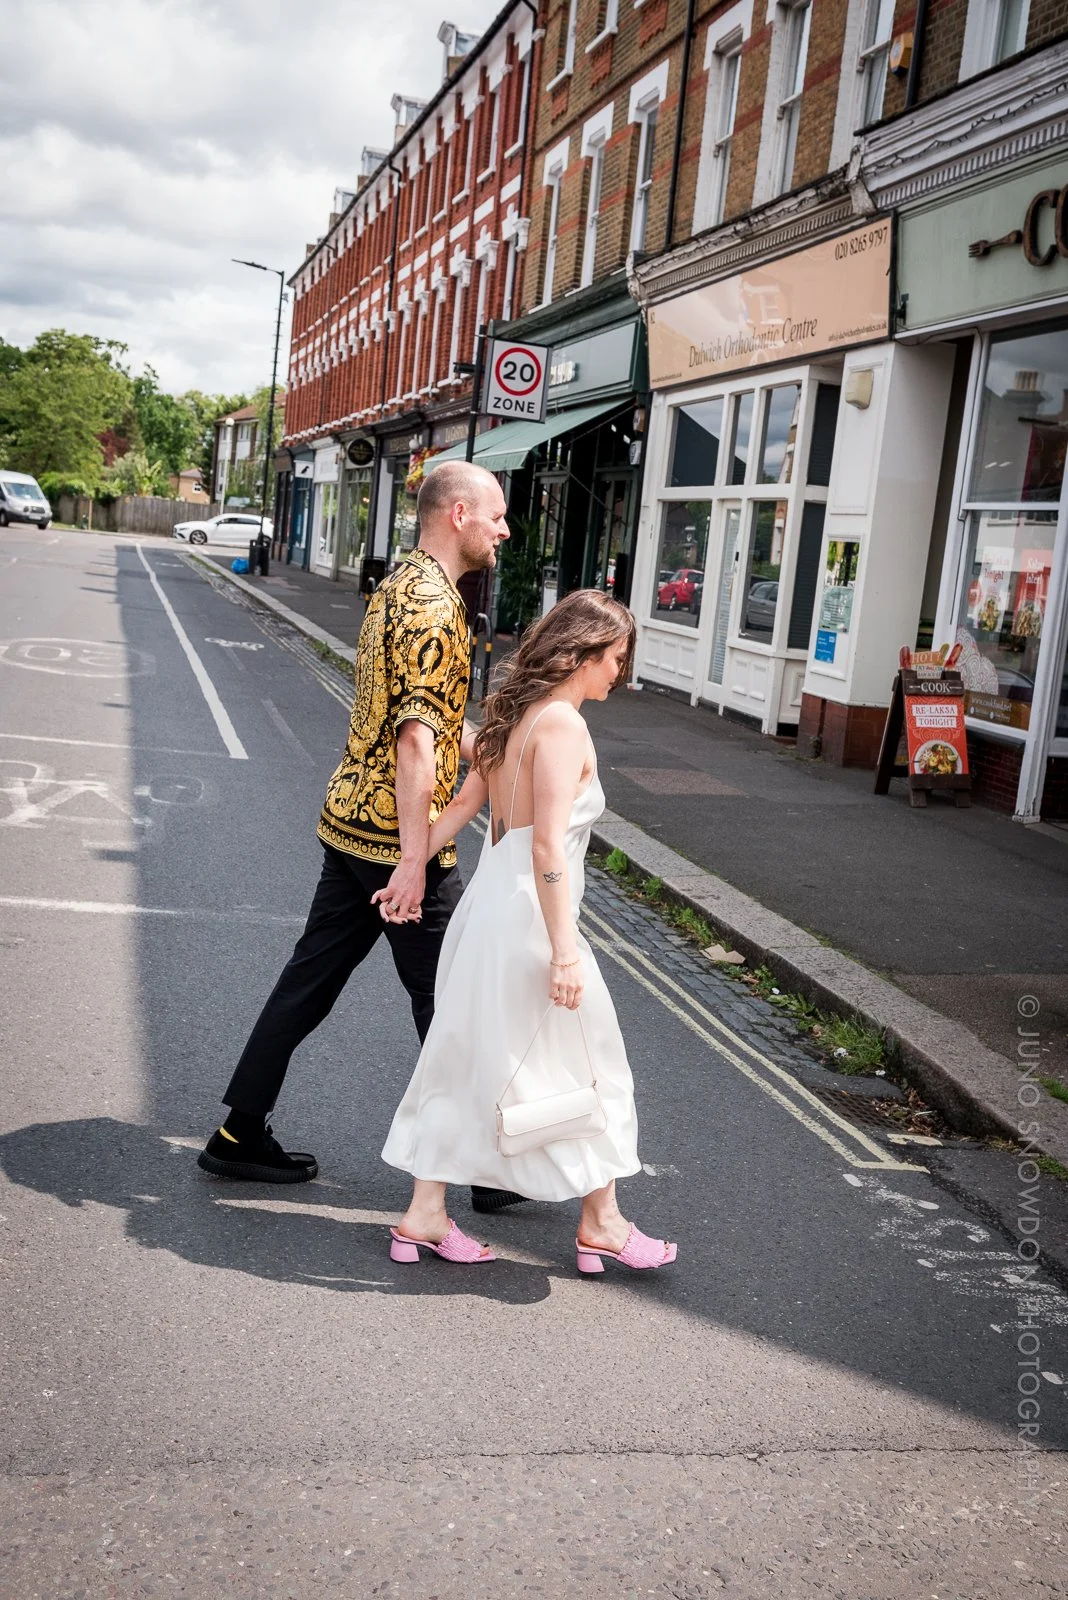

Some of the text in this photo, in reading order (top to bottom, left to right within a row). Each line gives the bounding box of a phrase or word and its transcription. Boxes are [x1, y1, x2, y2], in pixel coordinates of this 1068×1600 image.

[835, 226, 888, 261] 020 8265 9797
[689, 338, 722, 368] Dulwich
[724, 324, 779, 359] Orthodontic
[782, 317, 818, 344] Centre
[503, 360, 535, 383] 20
[493, 397, 536, 414] ZONE
[920, 681, 951, 693] COOK
[915, 706, 956, 715] RE-LAKSA
[919, 717, 955, 726] TONIGHT
